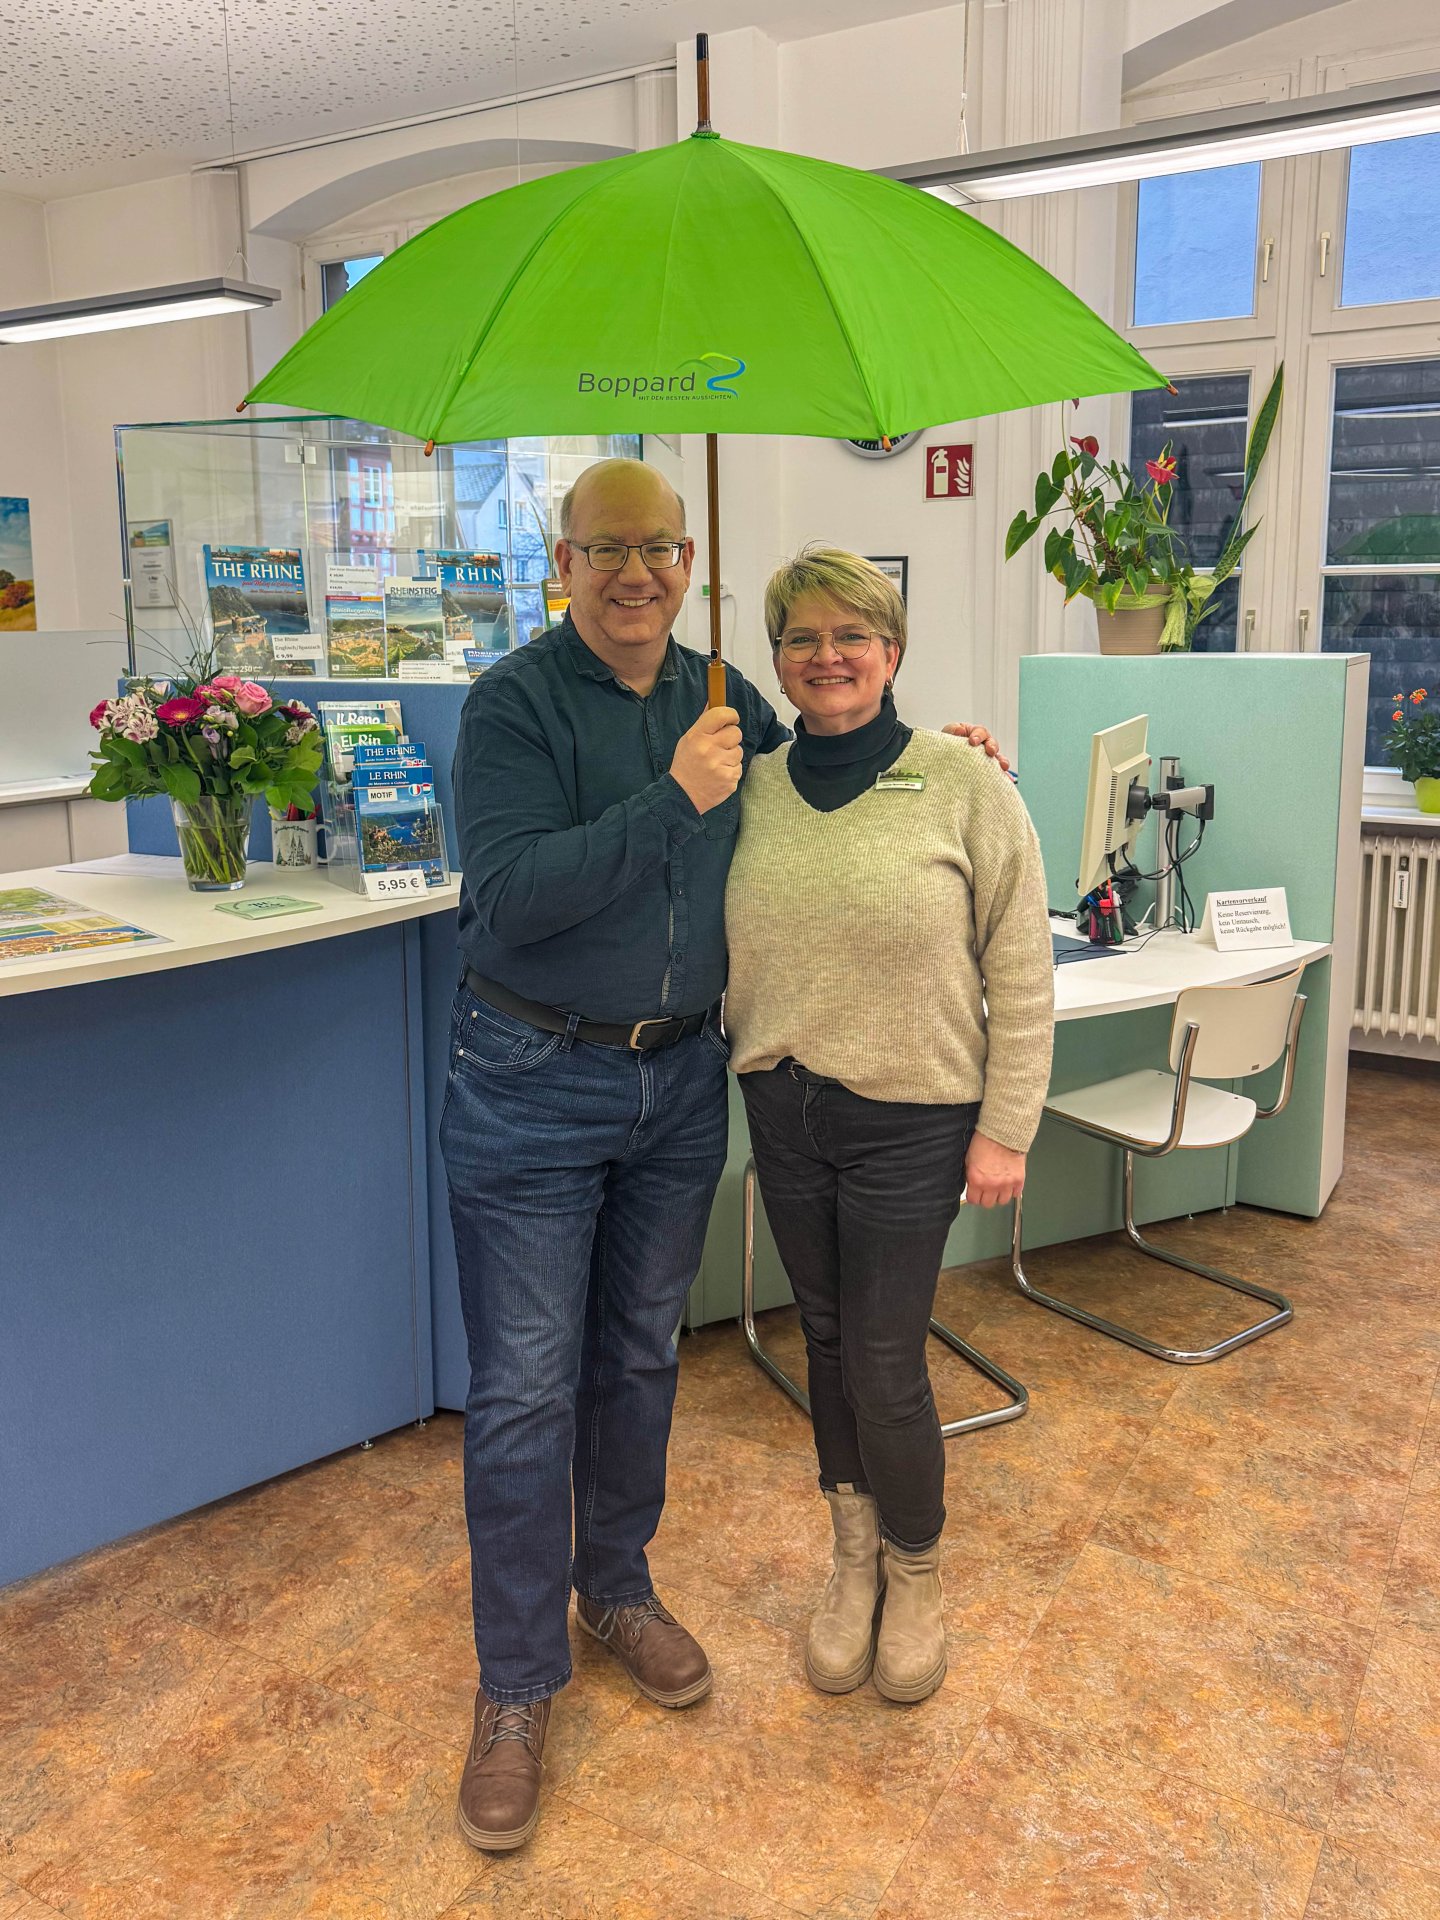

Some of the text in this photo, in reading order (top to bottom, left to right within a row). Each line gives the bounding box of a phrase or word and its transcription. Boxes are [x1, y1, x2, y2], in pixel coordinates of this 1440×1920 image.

[578, 372, 695, 397] Boppard
[211, 562, 302, 580] THE RHINE
[456, 567, 502, 581] RHIN
[390, 586, 437, 595] RHEINSTEIG
[240, 665, 252, 673] 250
[348, 712, 380, 725] Reno
[358, 734, 380, 746] Rin
[364, 746, 416, 757] THE RHINE
[369, 771, 407, 781] LE RHIN
[370, 791, 393, 799] MOTIF
[378, 879, 407, 891] 5,95
[410, 878, 420, 888] €
[1216, 896, 1267, 907] Kartenvorverkauf
[1235, 909, 1271, 917] Reservierung,
[1236, 926, 1261, 934] Rückgabe
[1263, 923, 1286, 931] möglich!
